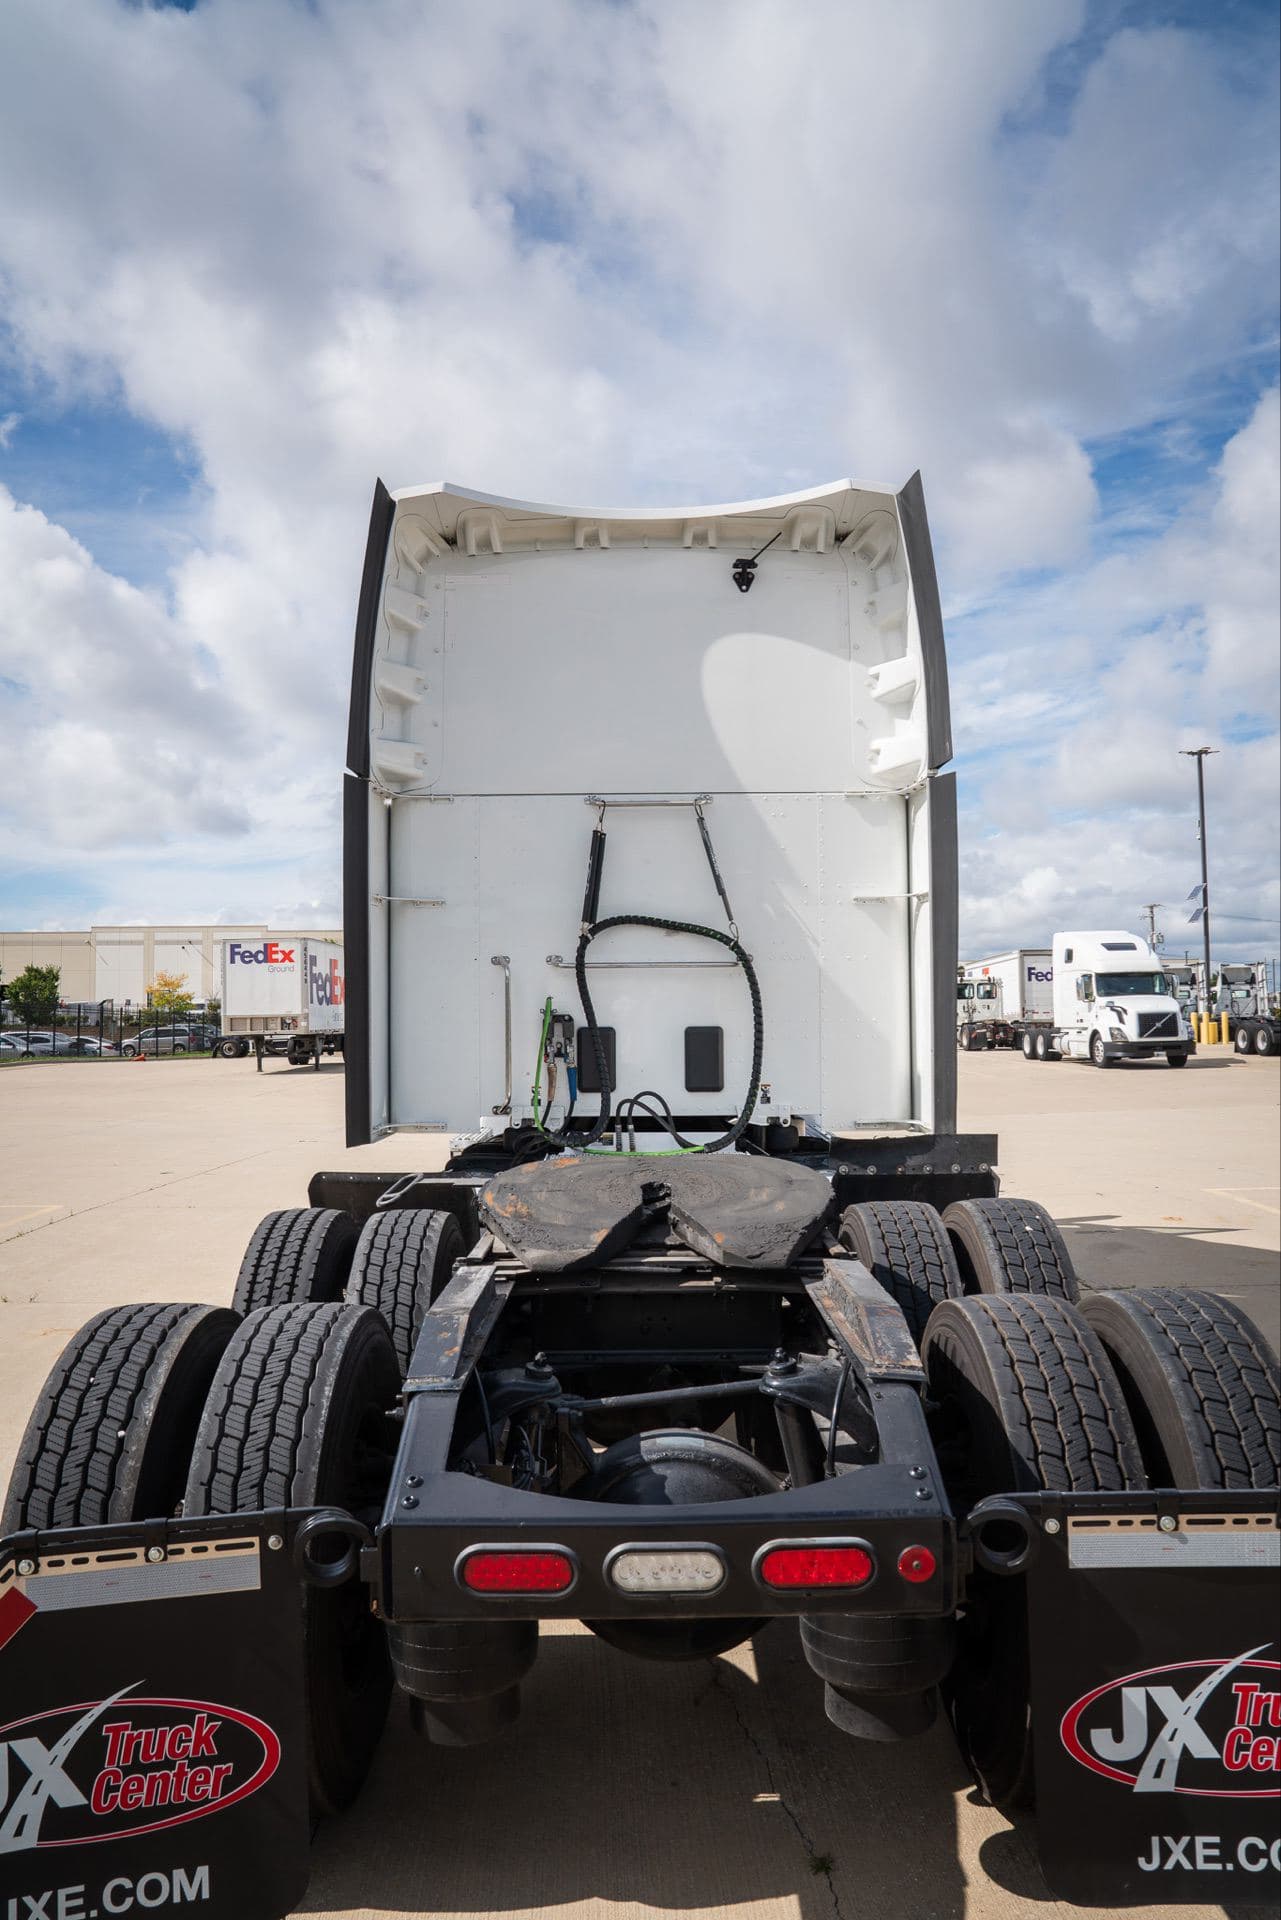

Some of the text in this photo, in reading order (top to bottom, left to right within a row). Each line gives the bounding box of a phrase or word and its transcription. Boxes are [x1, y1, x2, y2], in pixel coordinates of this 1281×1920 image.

[230, 943, 295, 964] FedEx
[268, 965, 295, 973] Ground
[103, 1714, 222, 1768] Truck
[1090, 1662, 1240, 1792] JX
[91, 1761, 233, 1815] Center
